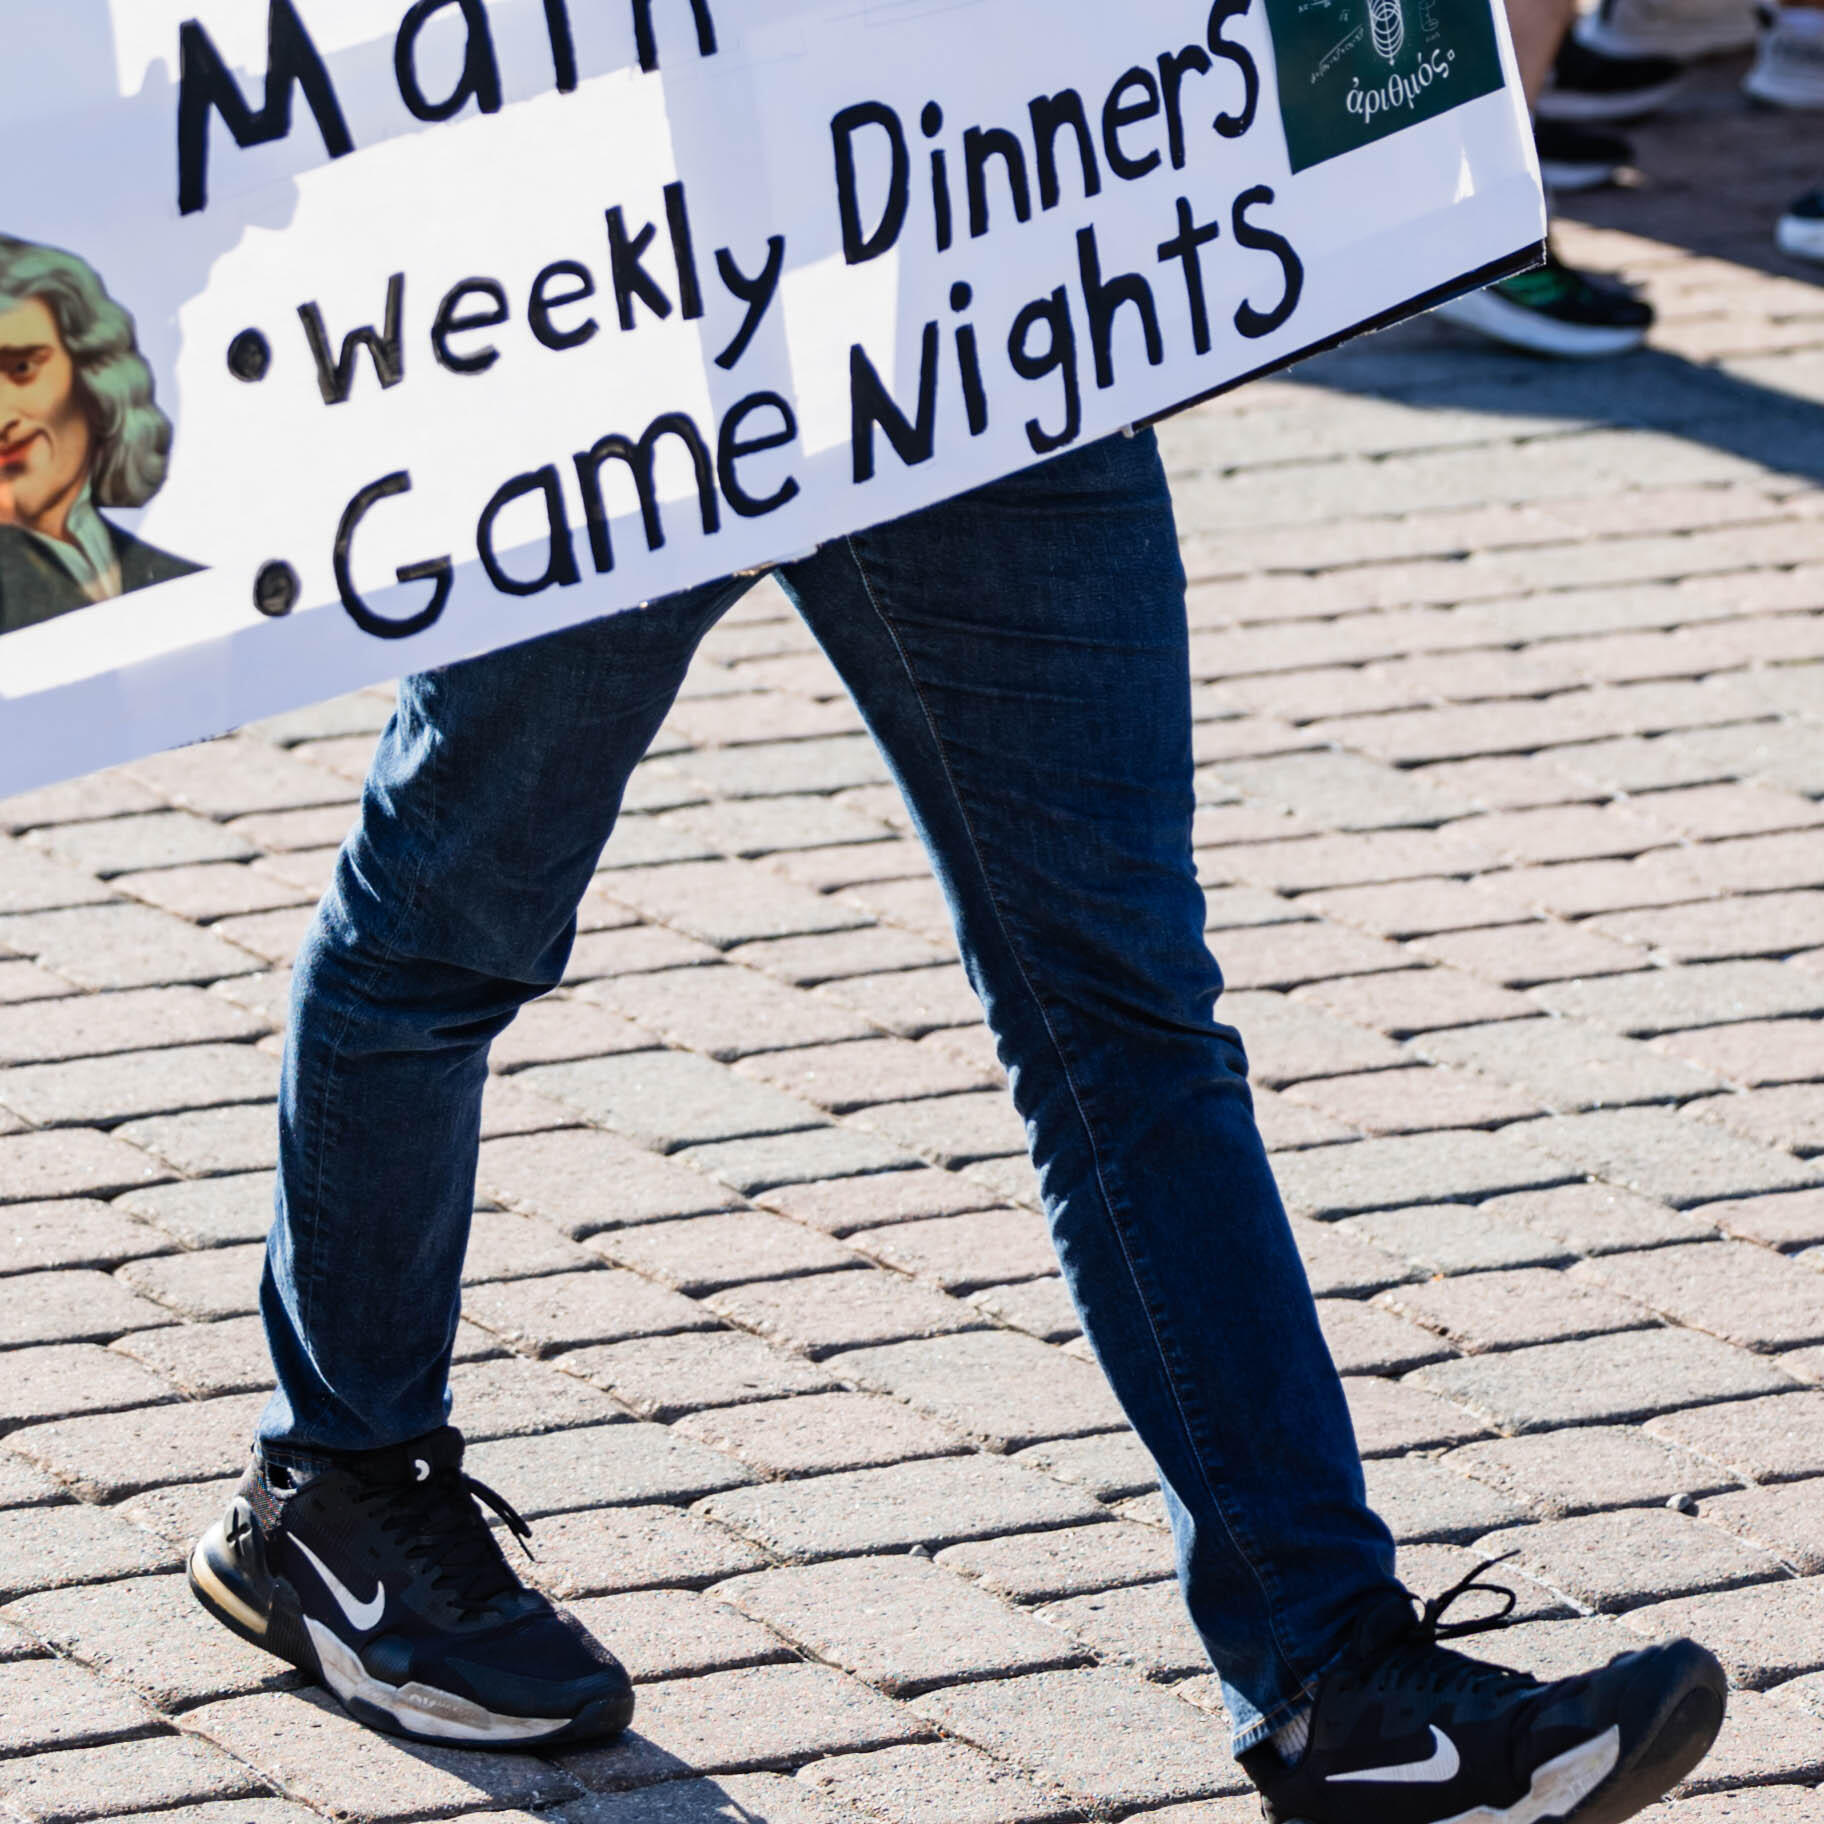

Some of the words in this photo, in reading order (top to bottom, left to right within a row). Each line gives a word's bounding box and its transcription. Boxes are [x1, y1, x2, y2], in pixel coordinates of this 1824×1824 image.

[297, 181, 785, 406] Weekly
[333, 391, 800, 640] Game
[849, 184, 1305, 471] Nights
